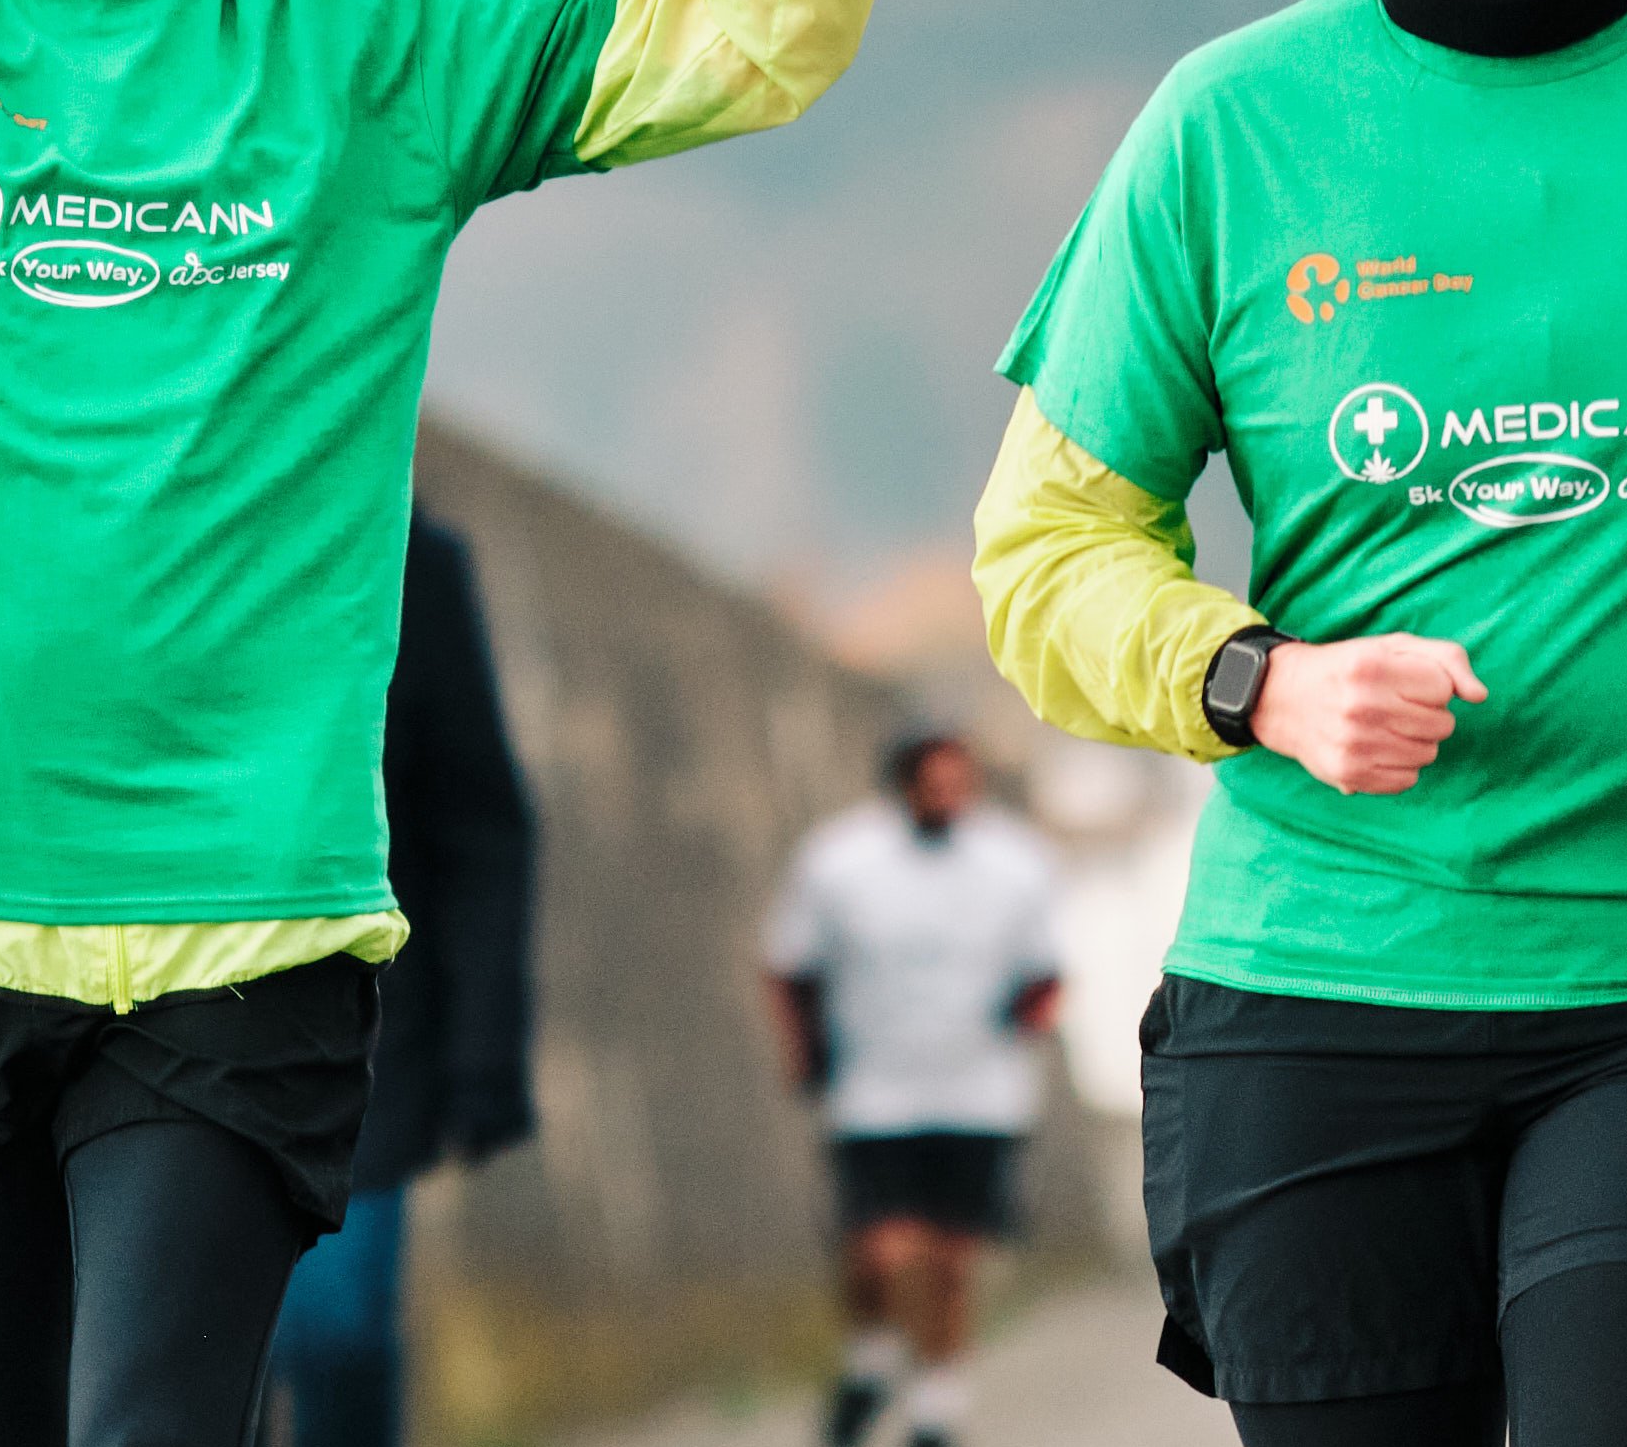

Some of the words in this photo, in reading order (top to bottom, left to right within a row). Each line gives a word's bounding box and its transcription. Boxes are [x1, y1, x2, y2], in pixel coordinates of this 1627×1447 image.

[10, 193, 274, 235] MEDICANN
[20, 257, 81, 281] Your
[86, 261, 147, 287] Way.
[169, 251, 225, 286] abc
[227, 262, 290, 282] Jersey
[1356, 254, 1416, 278] World
[1357, 279, 1429, 300] Cancer
[1433, 273, 1473, 293] Day
[1409, 485, 1443, 506] 5k
[1459, 479, 1524, 502] Your
[1529, 474, 1595, 501] Way.
